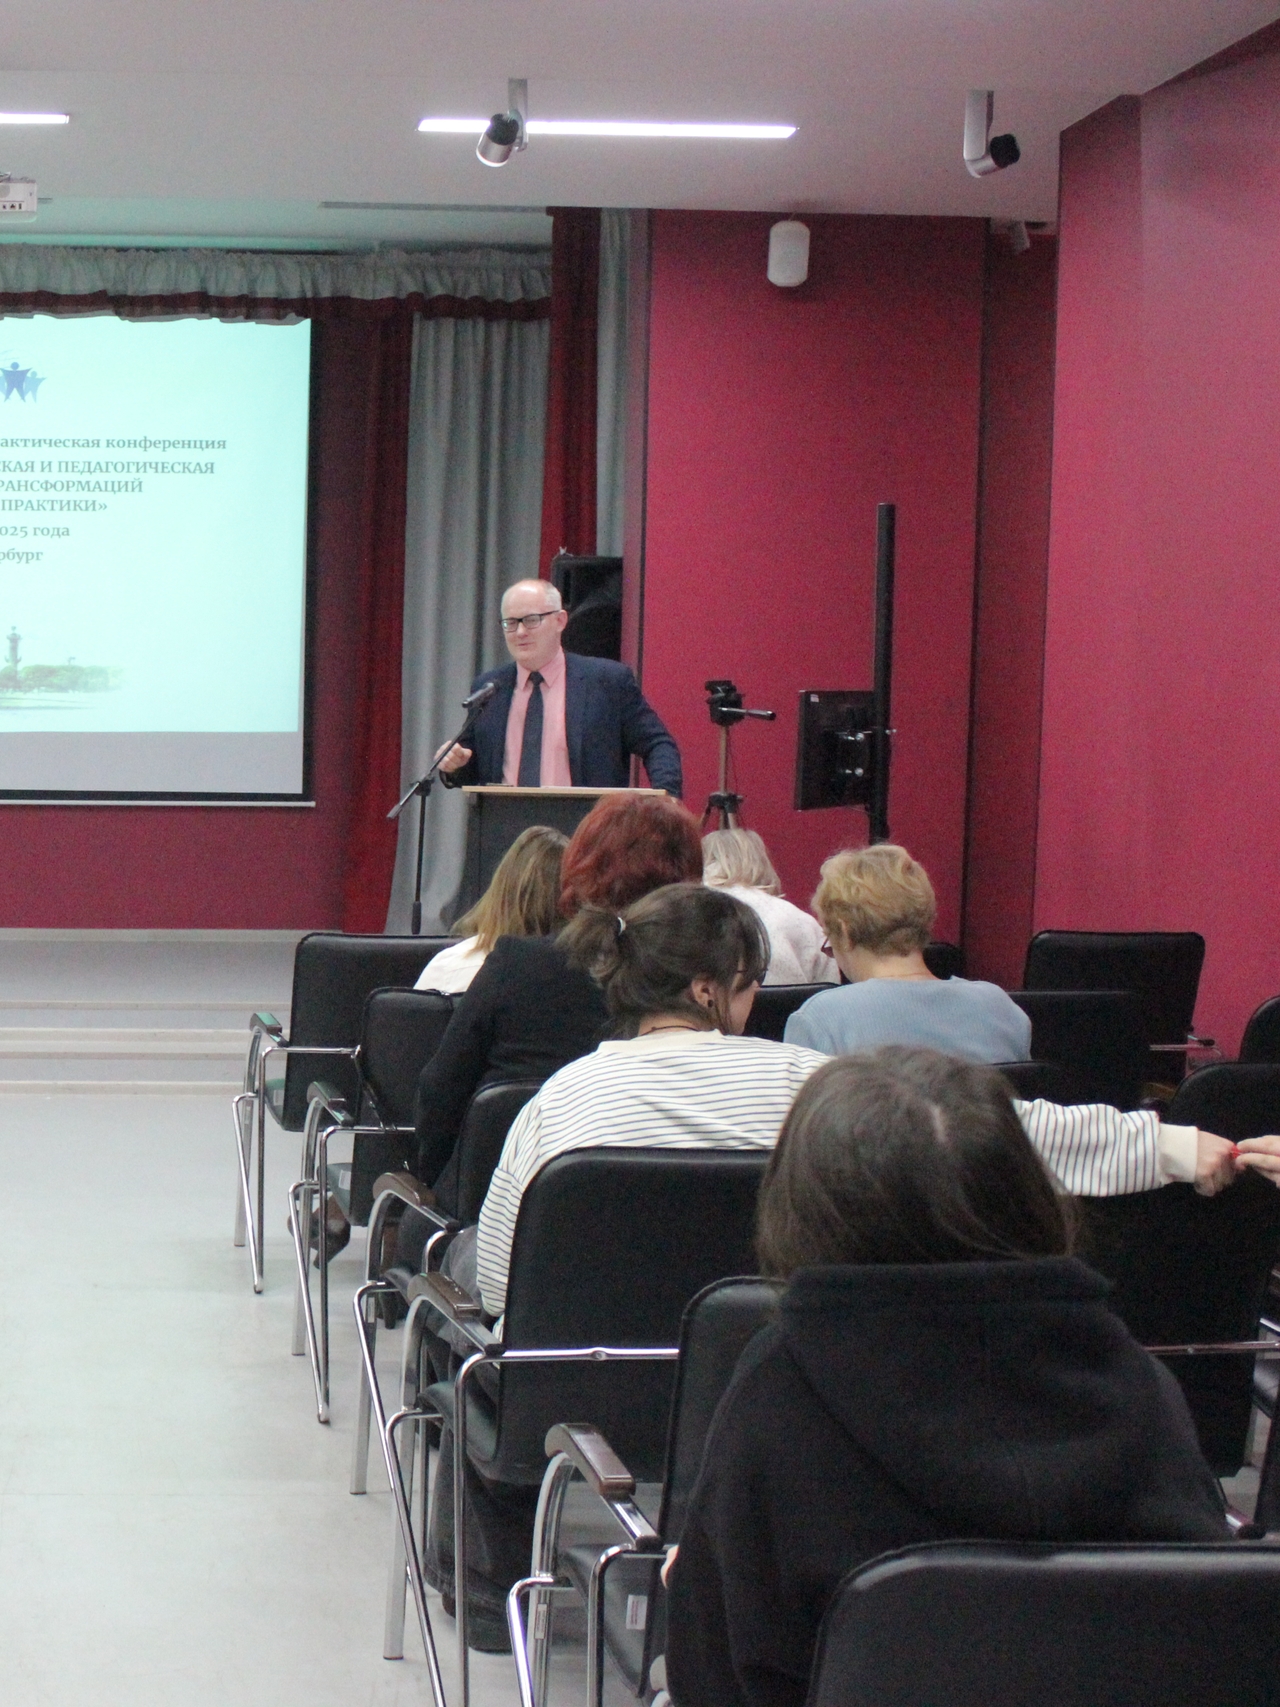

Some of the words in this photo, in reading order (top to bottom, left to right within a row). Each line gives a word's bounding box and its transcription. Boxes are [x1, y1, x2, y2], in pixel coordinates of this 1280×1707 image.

[104, 435, 228, 453] конференция
[39, 460, 53, 473] И
[57, 460, 216, 476] ПЕДАГОГИЧЕСКАЯ
[0, 498, 108, 513] ПРАКТИКИ»
[32, 526, 71, 539] года
